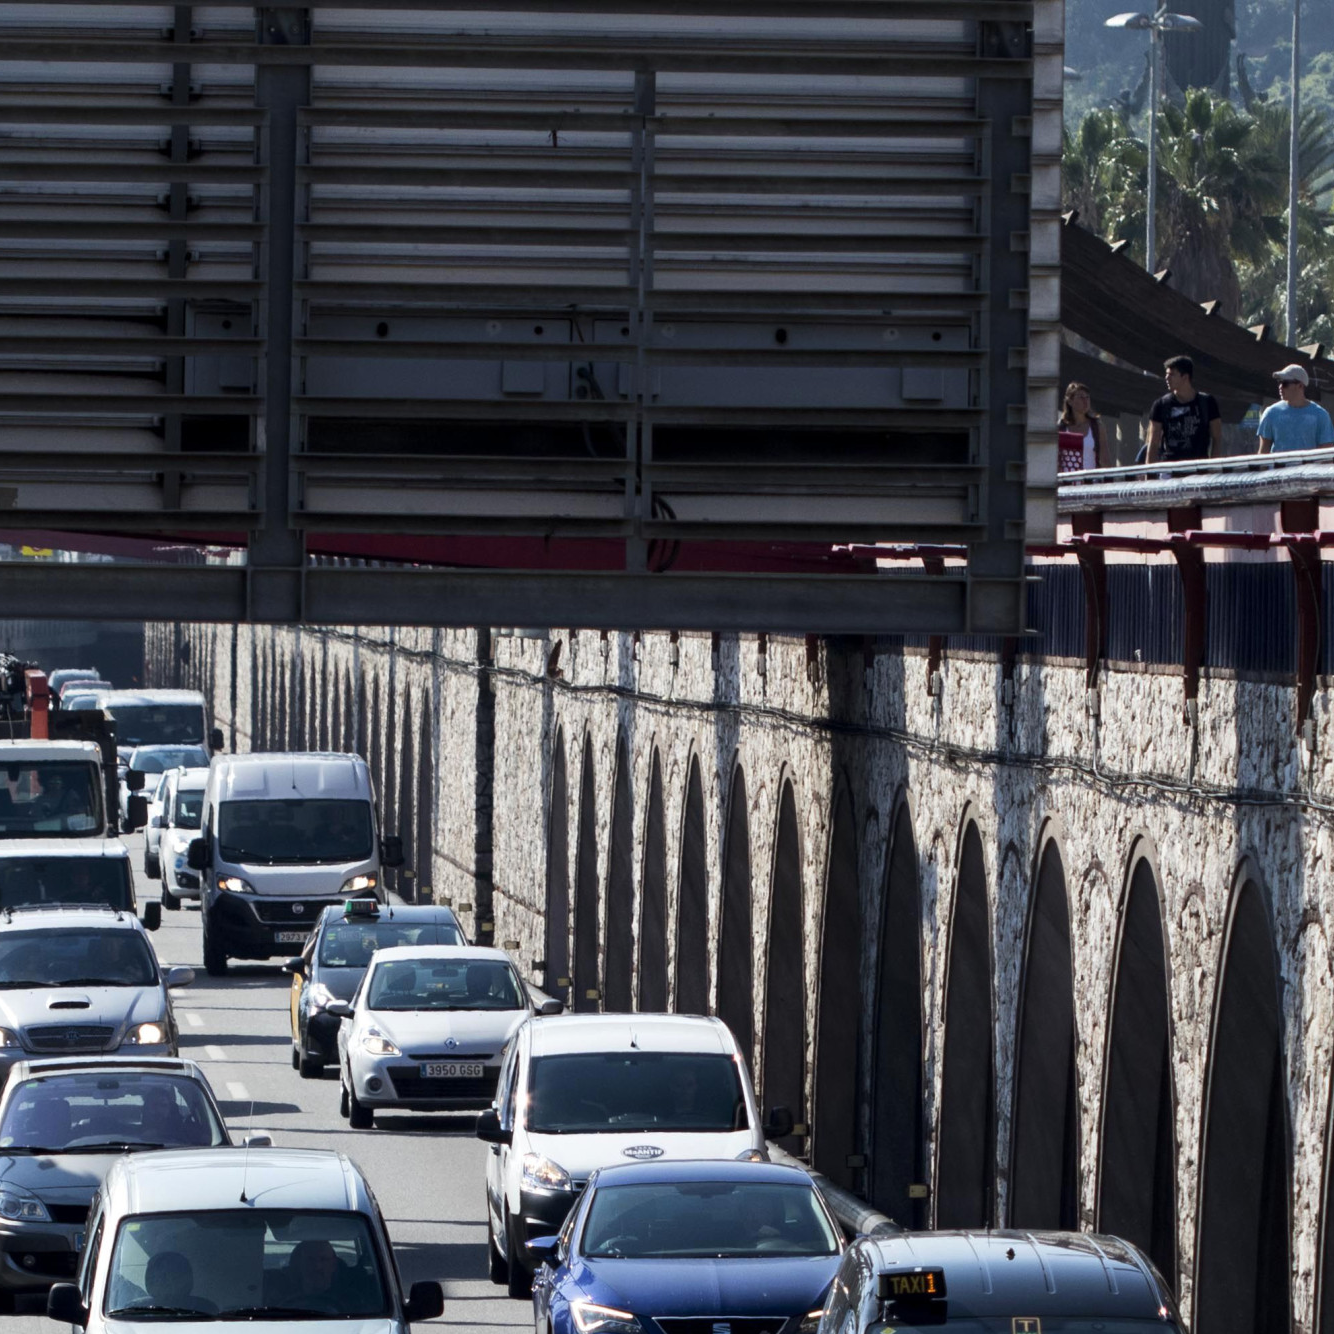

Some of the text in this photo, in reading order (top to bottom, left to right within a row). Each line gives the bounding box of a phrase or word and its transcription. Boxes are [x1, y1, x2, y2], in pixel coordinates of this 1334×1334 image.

[428, 1064, 481, 1076] 3950 GSG
[890, 1275, 926, 1295] TAXI
